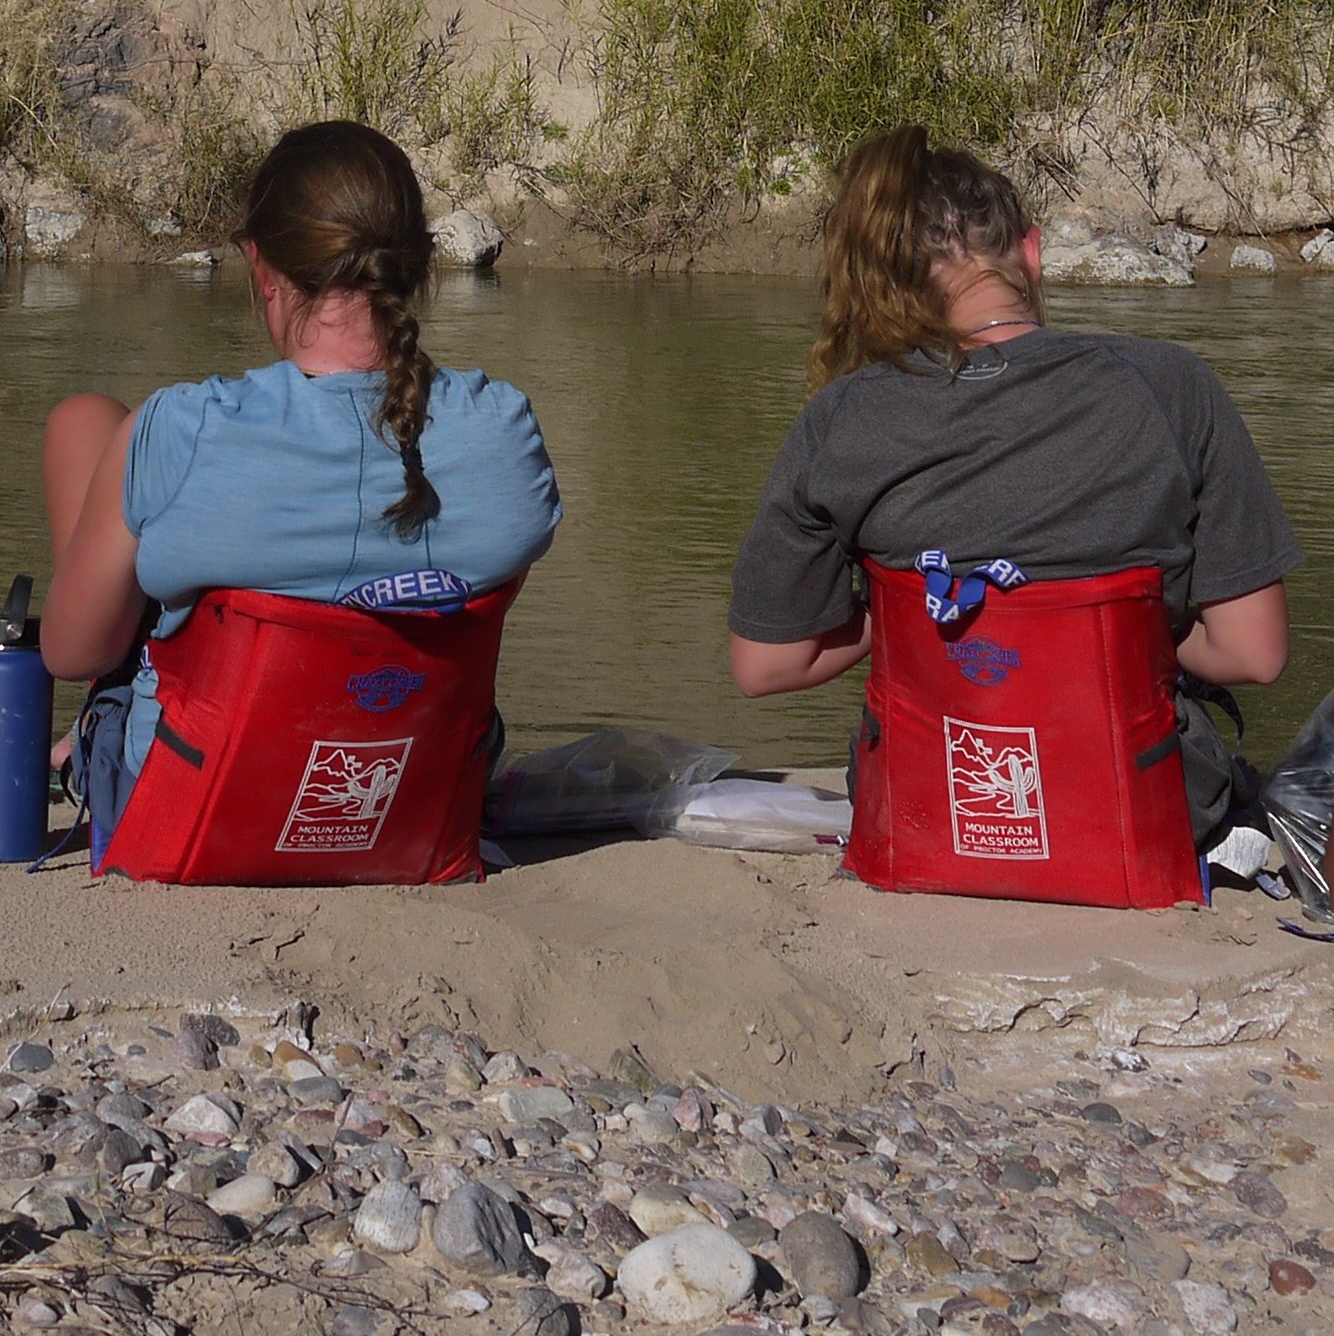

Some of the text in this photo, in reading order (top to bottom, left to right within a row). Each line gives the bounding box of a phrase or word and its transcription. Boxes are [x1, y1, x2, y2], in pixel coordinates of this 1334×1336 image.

[362, 570, 459, 607] CREEK
[297, 825, 369, 834] MOUNTAIN
[965, 822, 1033, 836] MOUNTAIN
[290, 833, 369, 843] CLASSROOM
[963, 834, 1039, 847] CLASSROOM
